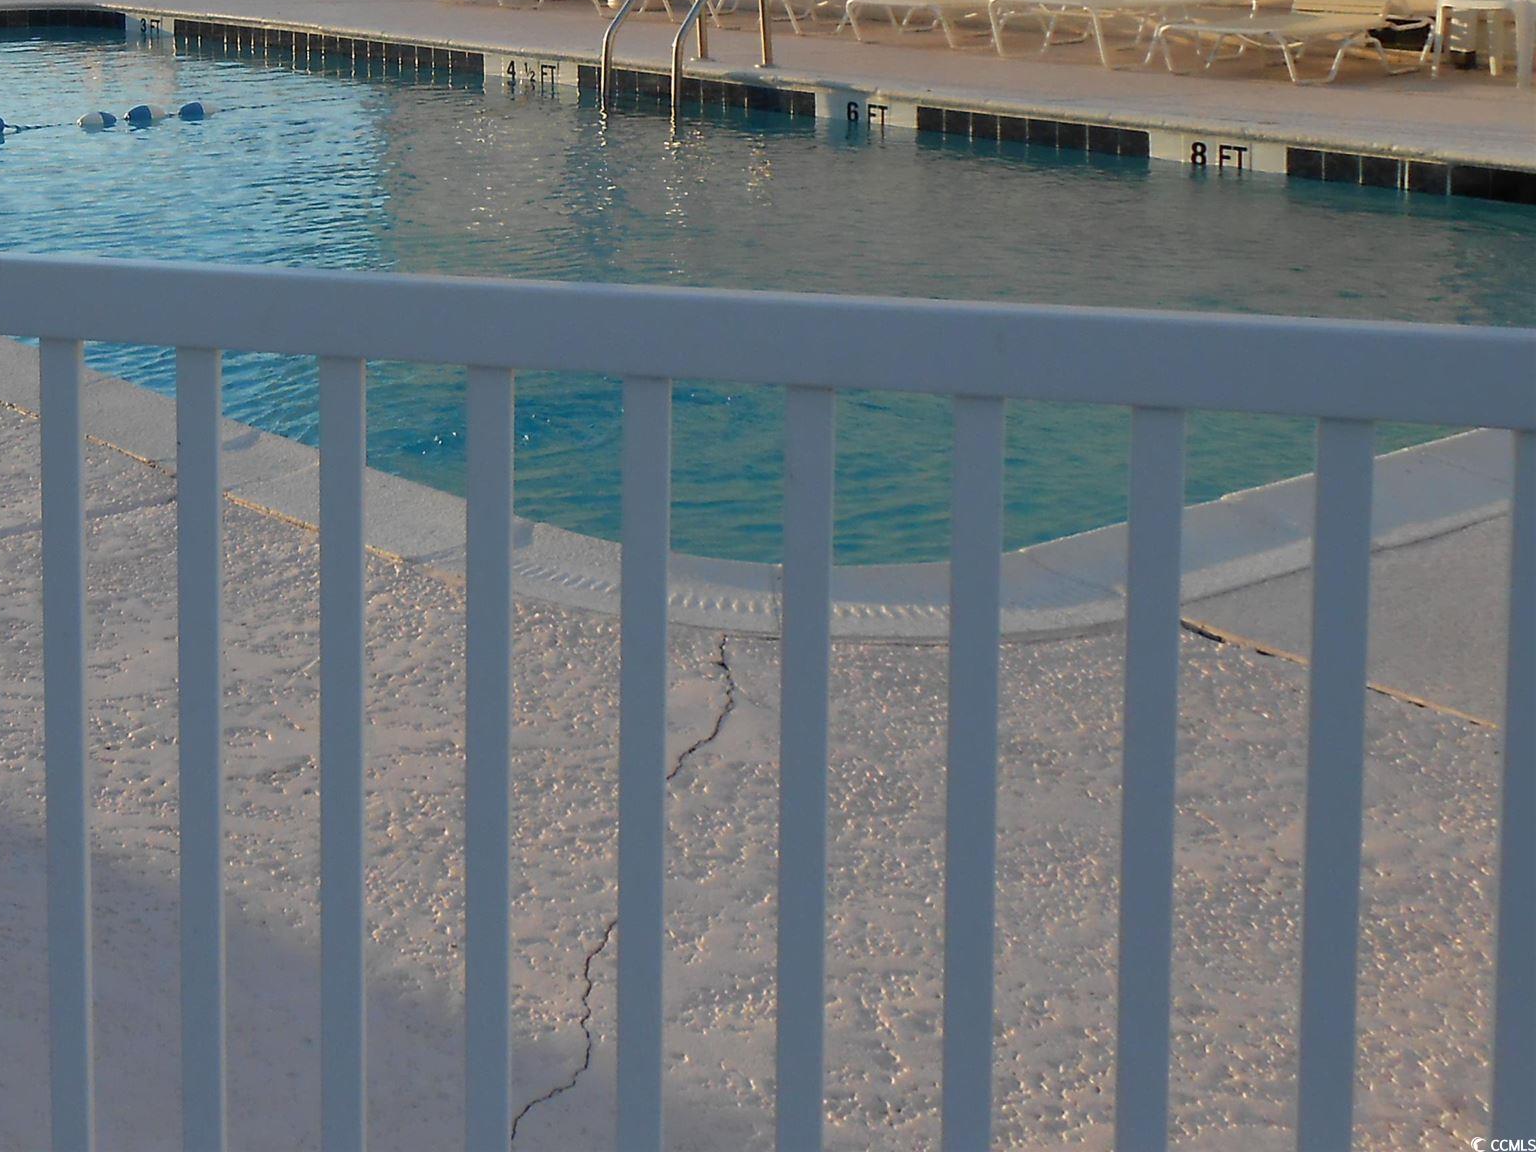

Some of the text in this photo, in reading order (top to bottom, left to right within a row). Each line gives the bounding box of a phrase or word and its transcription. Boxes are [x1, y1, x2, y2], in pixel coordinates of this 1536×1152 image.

[140, 17, 147, 33] 3
[507, 60, 516, 81] 4
[541, 64, 556, 85] FT
[847, 101, 888, 126] 6 FT
[1191, 142, 1248, 169] 8 FT
